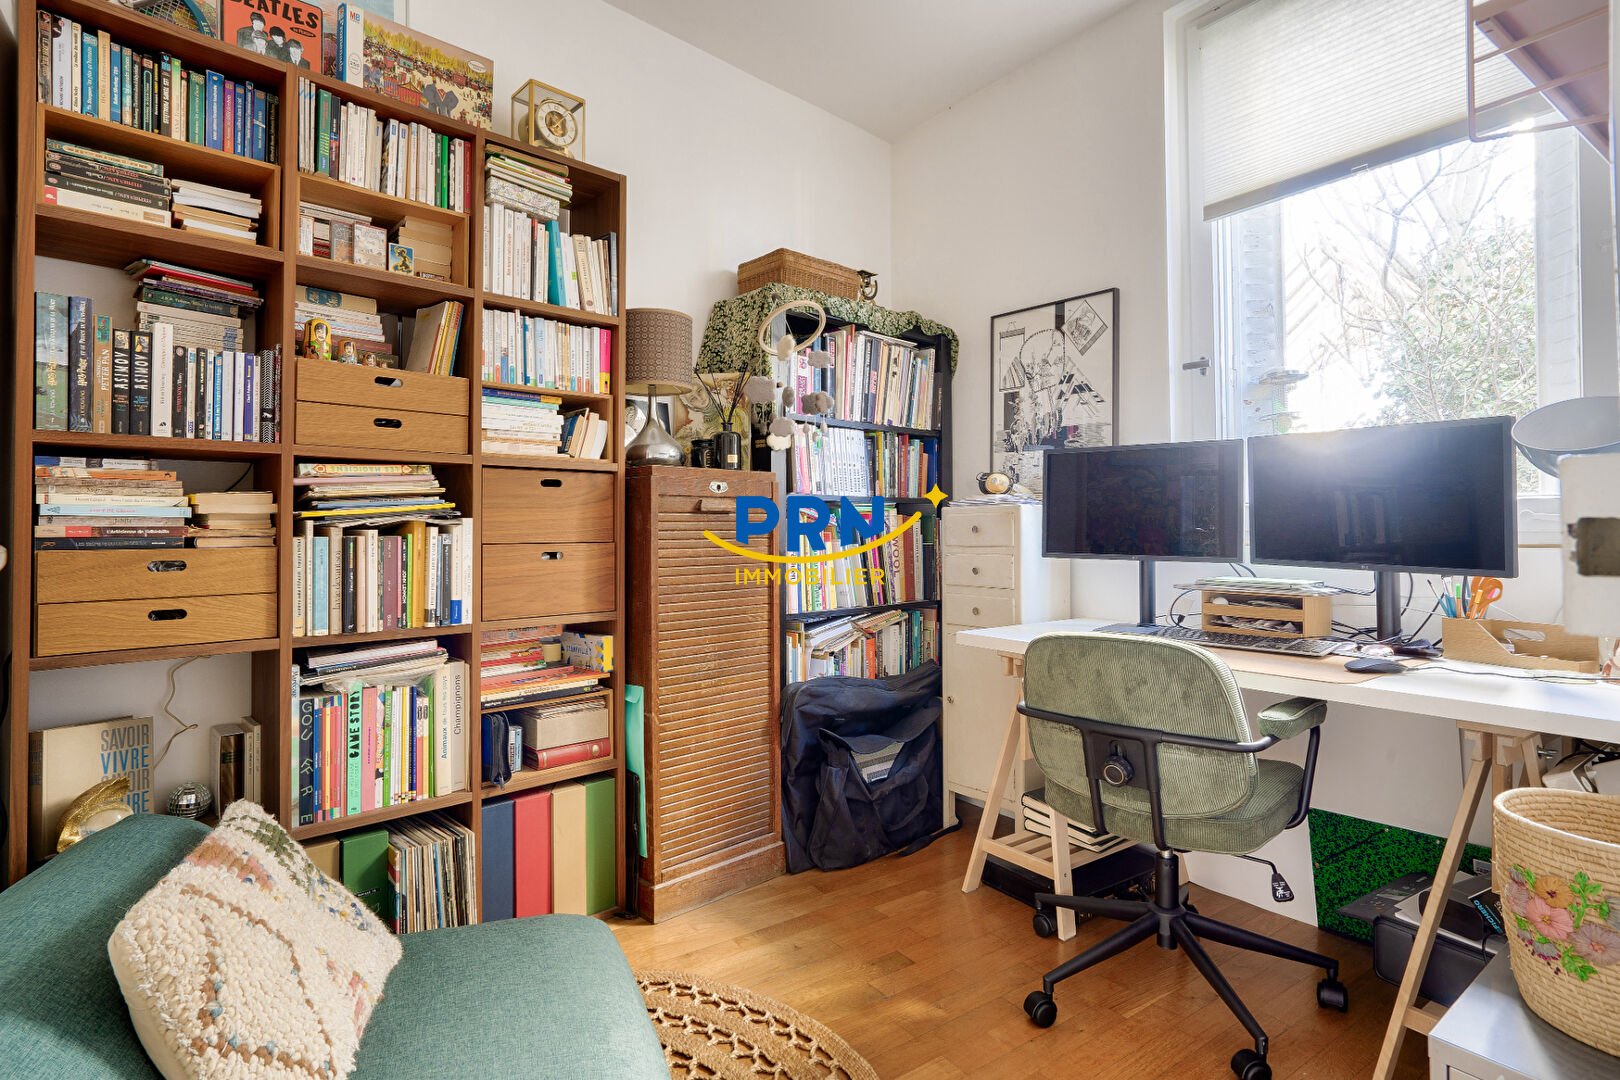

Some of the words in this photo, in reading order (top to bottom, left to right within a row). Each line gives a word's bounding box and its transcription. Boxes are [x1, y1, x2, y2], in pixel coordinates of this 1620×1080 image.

[230, 0, 319, 29] EATLES
[350, 10, 361, 21] MB
[101, 349, 110, 364] PAN
[114, 351, 128, 390] ASIMOV
[101, 366, 109, 391] PETER
[134, 354, 149, 390] ASIMOV
[349, 690, 360, 724] STORY
[453, 674, 463, 735] Champignons
[100, 724, 149, 752] SAVOIR
[349, 727, 360, 758] GAME
[100, 746, 149, 775] VIVRE
[1474, 900, 1502, 934] FICHERO
